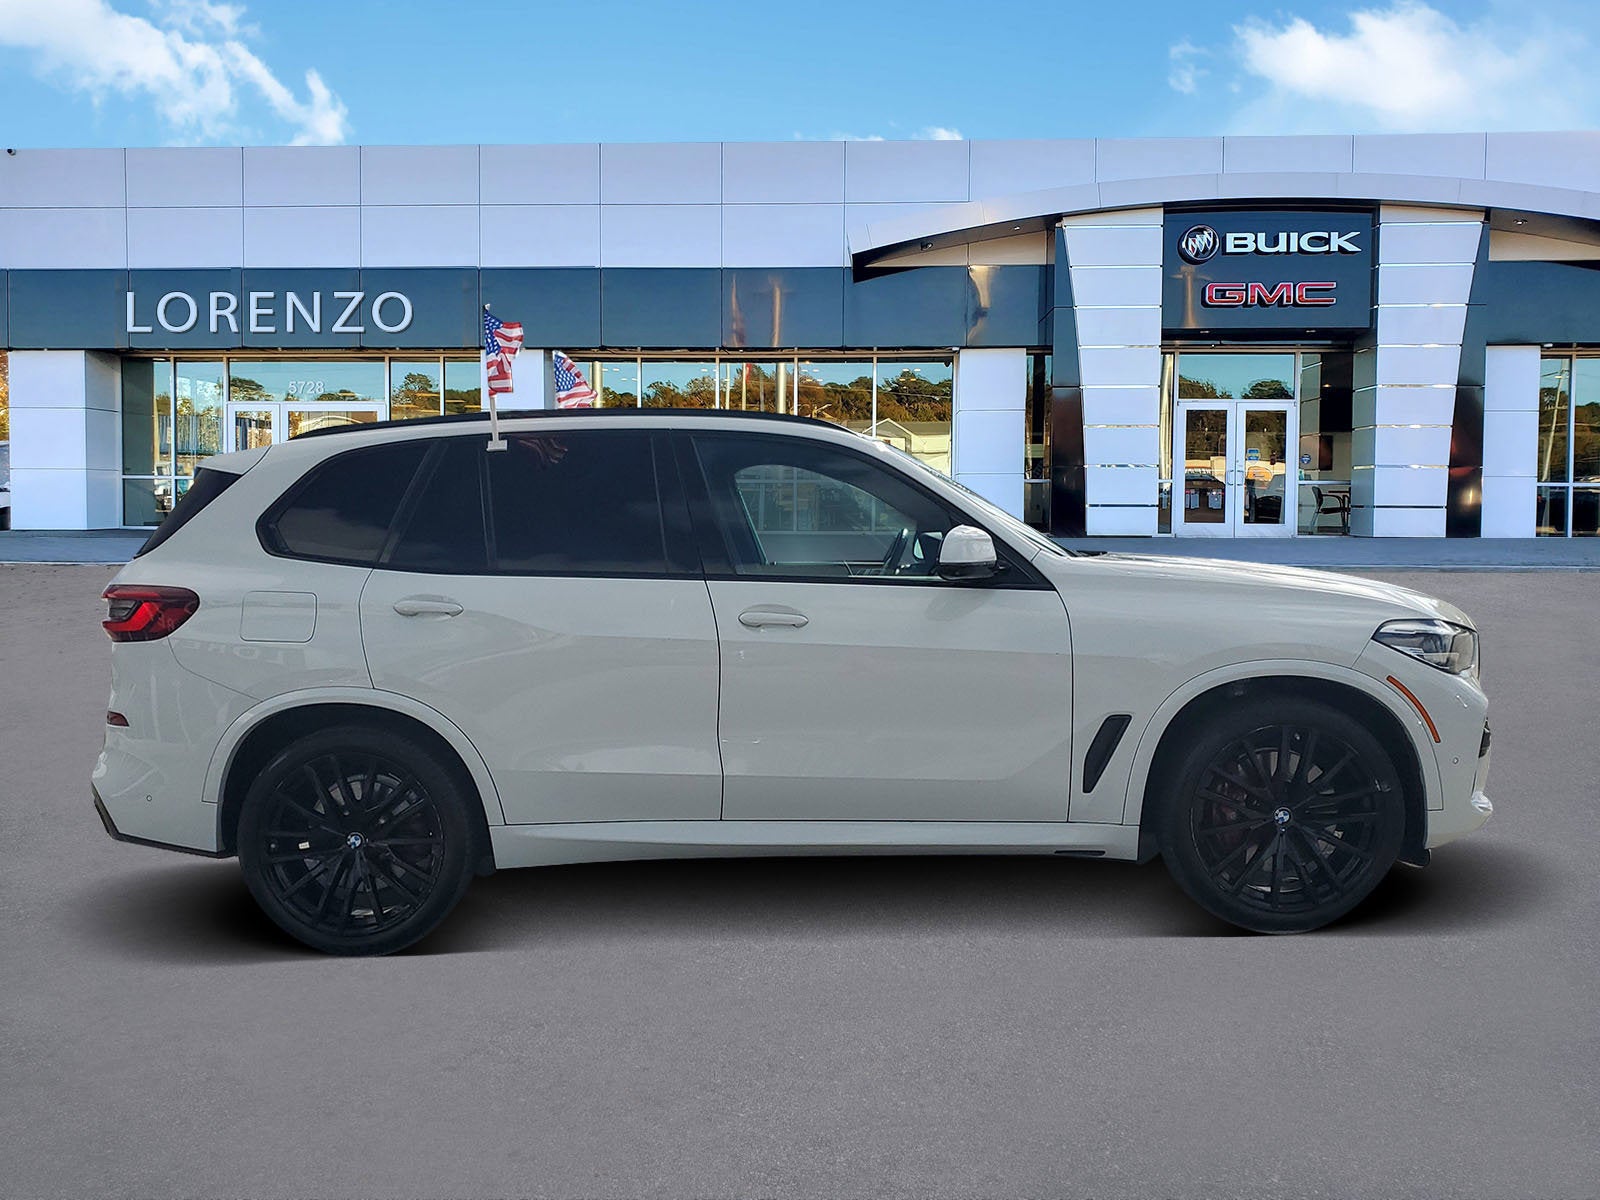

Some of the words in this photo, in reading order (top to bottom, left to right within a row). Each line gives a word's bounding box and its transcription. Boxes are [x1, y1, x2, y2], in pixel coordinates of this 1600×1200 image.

[1225, 231, 1362, 253] BUICK
[1205, 281, 1337, 305] GMC
[126, 291, 414, 333] LORENZO
[288, 381, 325, 394] 5728
